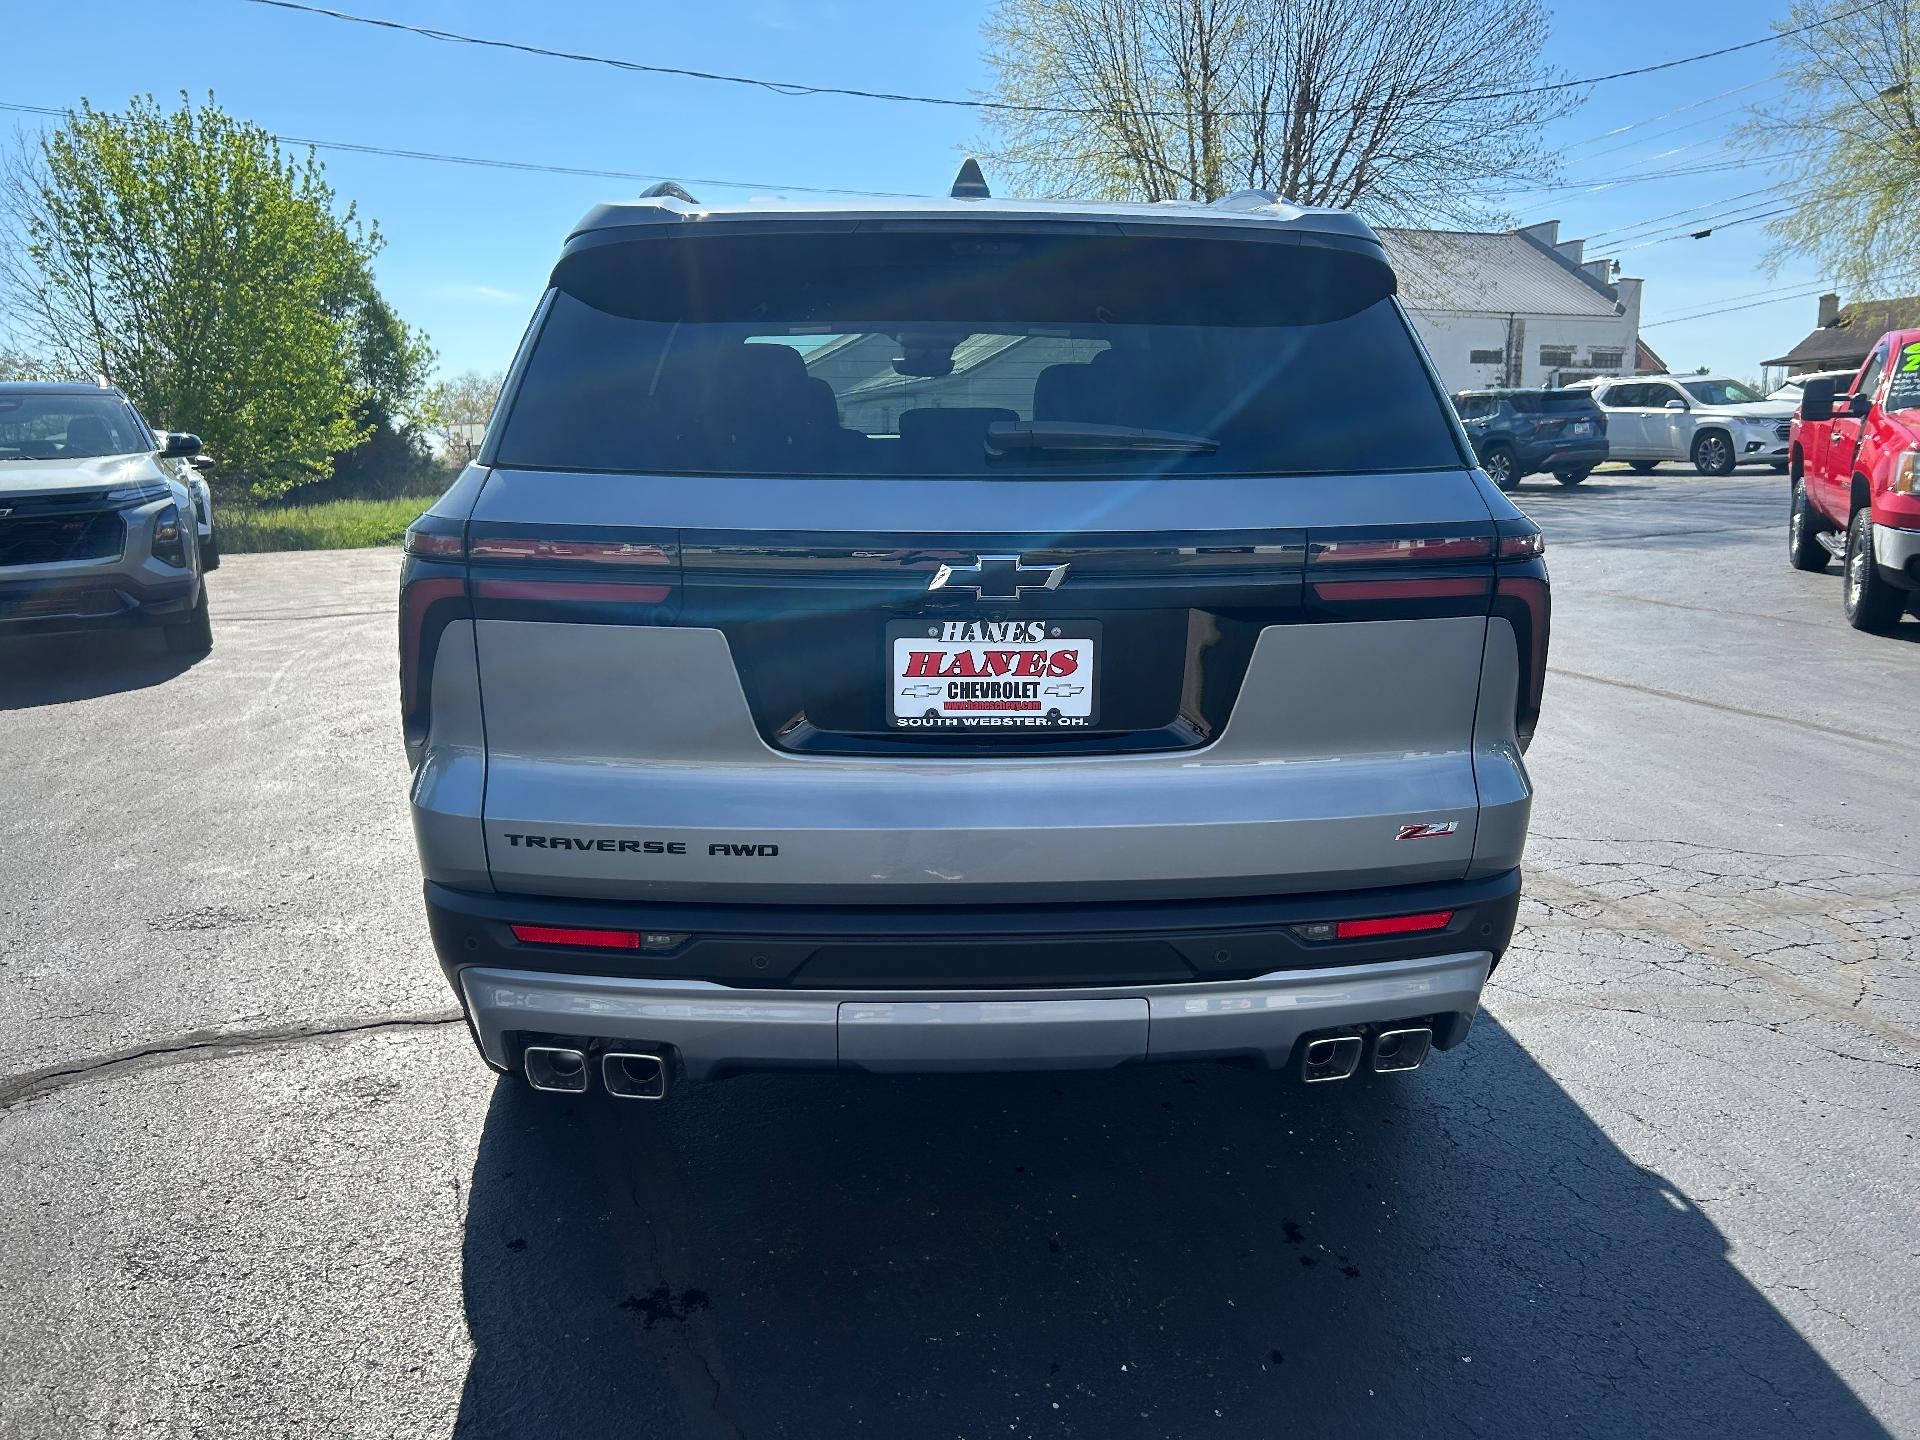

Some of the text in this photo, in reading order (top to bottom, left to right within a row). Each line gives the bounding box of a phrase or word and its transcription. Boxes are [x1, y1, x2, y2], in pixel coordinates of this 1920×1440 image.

[938, 620, 1046, 643] HANES
[902, 650, 1079, 678] HANES
[947, 681, 1040, 699] CHEVROLET
[944, 700, 1041, 711] www.haneschevy.com
[896, 717, 1089, 727] SOUTH WEBSTER, OH.
[503, 833, 779, 857] TRAVERSE AWD
